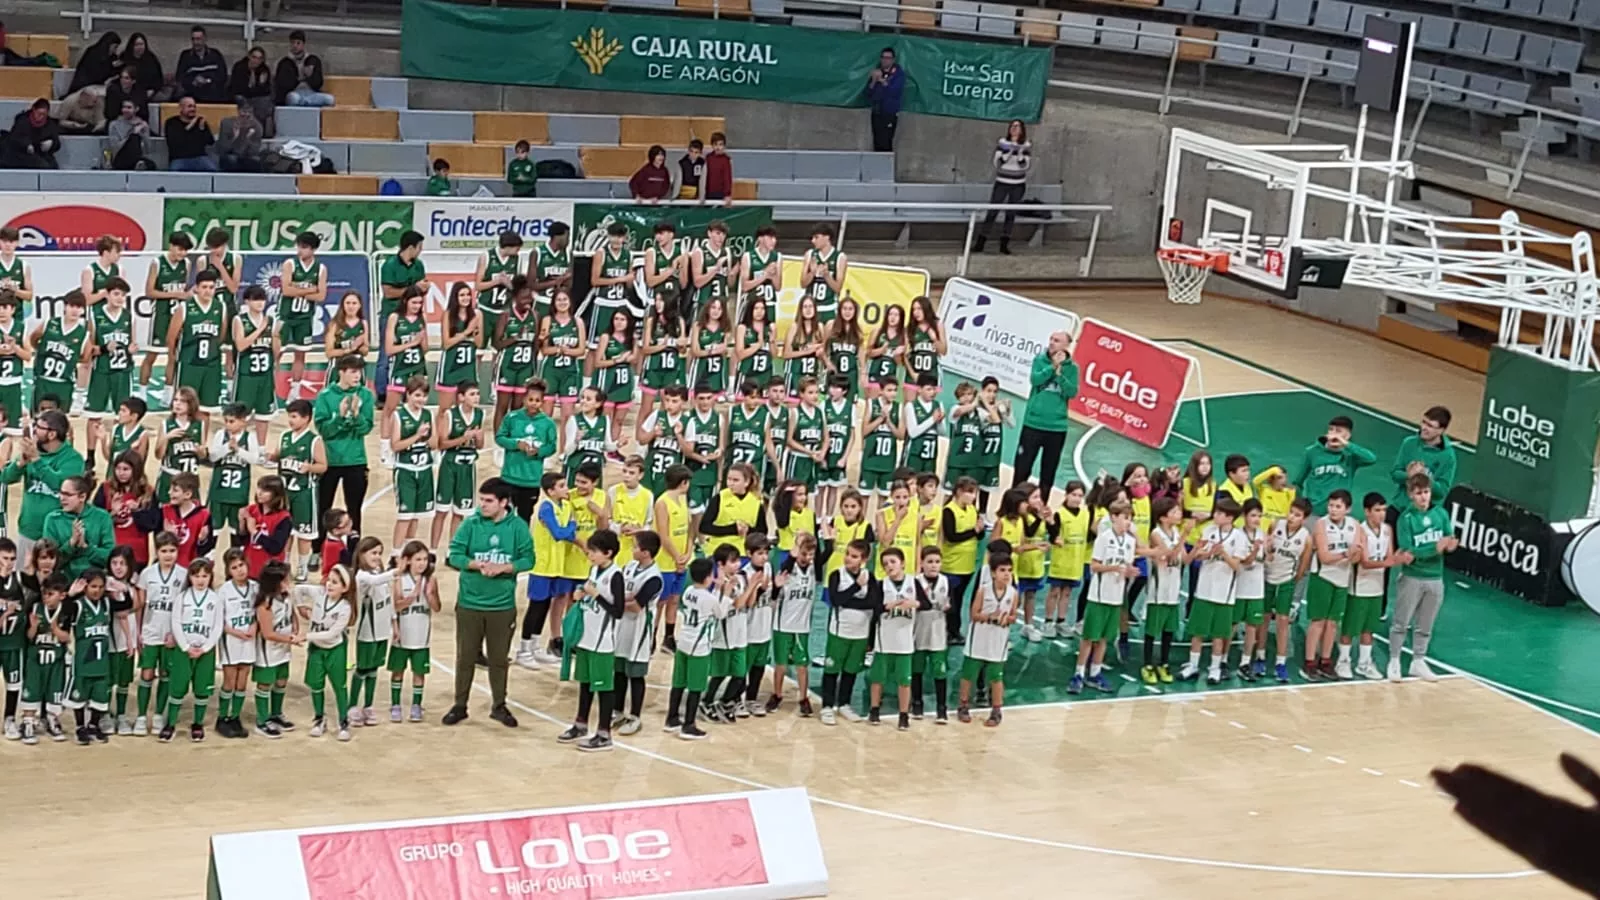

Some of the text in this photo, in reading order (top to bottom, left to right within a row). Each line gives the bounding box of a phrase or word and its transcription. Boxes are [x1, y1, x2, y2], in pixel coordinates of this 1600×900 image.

[631, 36, 779, 65] CAJA RURAL
[647, 63, 761, 85] DE ARAGÓN
[979, 64, 1015, 85] San
[943, 79, 1014, 101] Lorenzo
[491, 288, 507, 305] 14
[712, 280, 721, 296] 3
[812, 283, 826, 300] 18
[984, 324, 1016, 347] rivas
[1097, 336, 1123, 352] GRUPO
[199, 340, 209, 358] 8
[403, 349, 420, 364] 33
[456, 347, 472, 363] 31
[513, 346, 531, 364] 28
[44, 357, 66, 378] 99
[109, 352, 127, 369] 22
[250, 354, 270, 372] 33
[661, 353, 675, 369] 16
[707, 356, 721, 372] 15
[753, 355, 767, 372] 13
[801, 357, 816, 373] 12
[840, 356, 849, 373] 8
[880, 361, 890, 376] 5
[914, 355, 932, 371] 00
[616, 367, 629, 384] 18
[1085, 362, 1158, 409] Lobe
[1489, 398, 1554, 436] Lobe
[876, 437, 891, 455] 10
[921, 440, 935, 458] 31
[964, 438, 973, 453] 3
[985, 438, 1001, 454] 77
[732, 448, 756, 464] 27
[221, 470, 242, 489] 32
[1451, 501, 1541, 576] Huesca
[38, 649, 56, 665] 10
[94, 641, 103, 660] 1
[399, 843, 464, 863] GRUPO
[474, 822, 672, 875] Lobe
[507, 867, 660, 896] HIGH QUALITY HOMES
